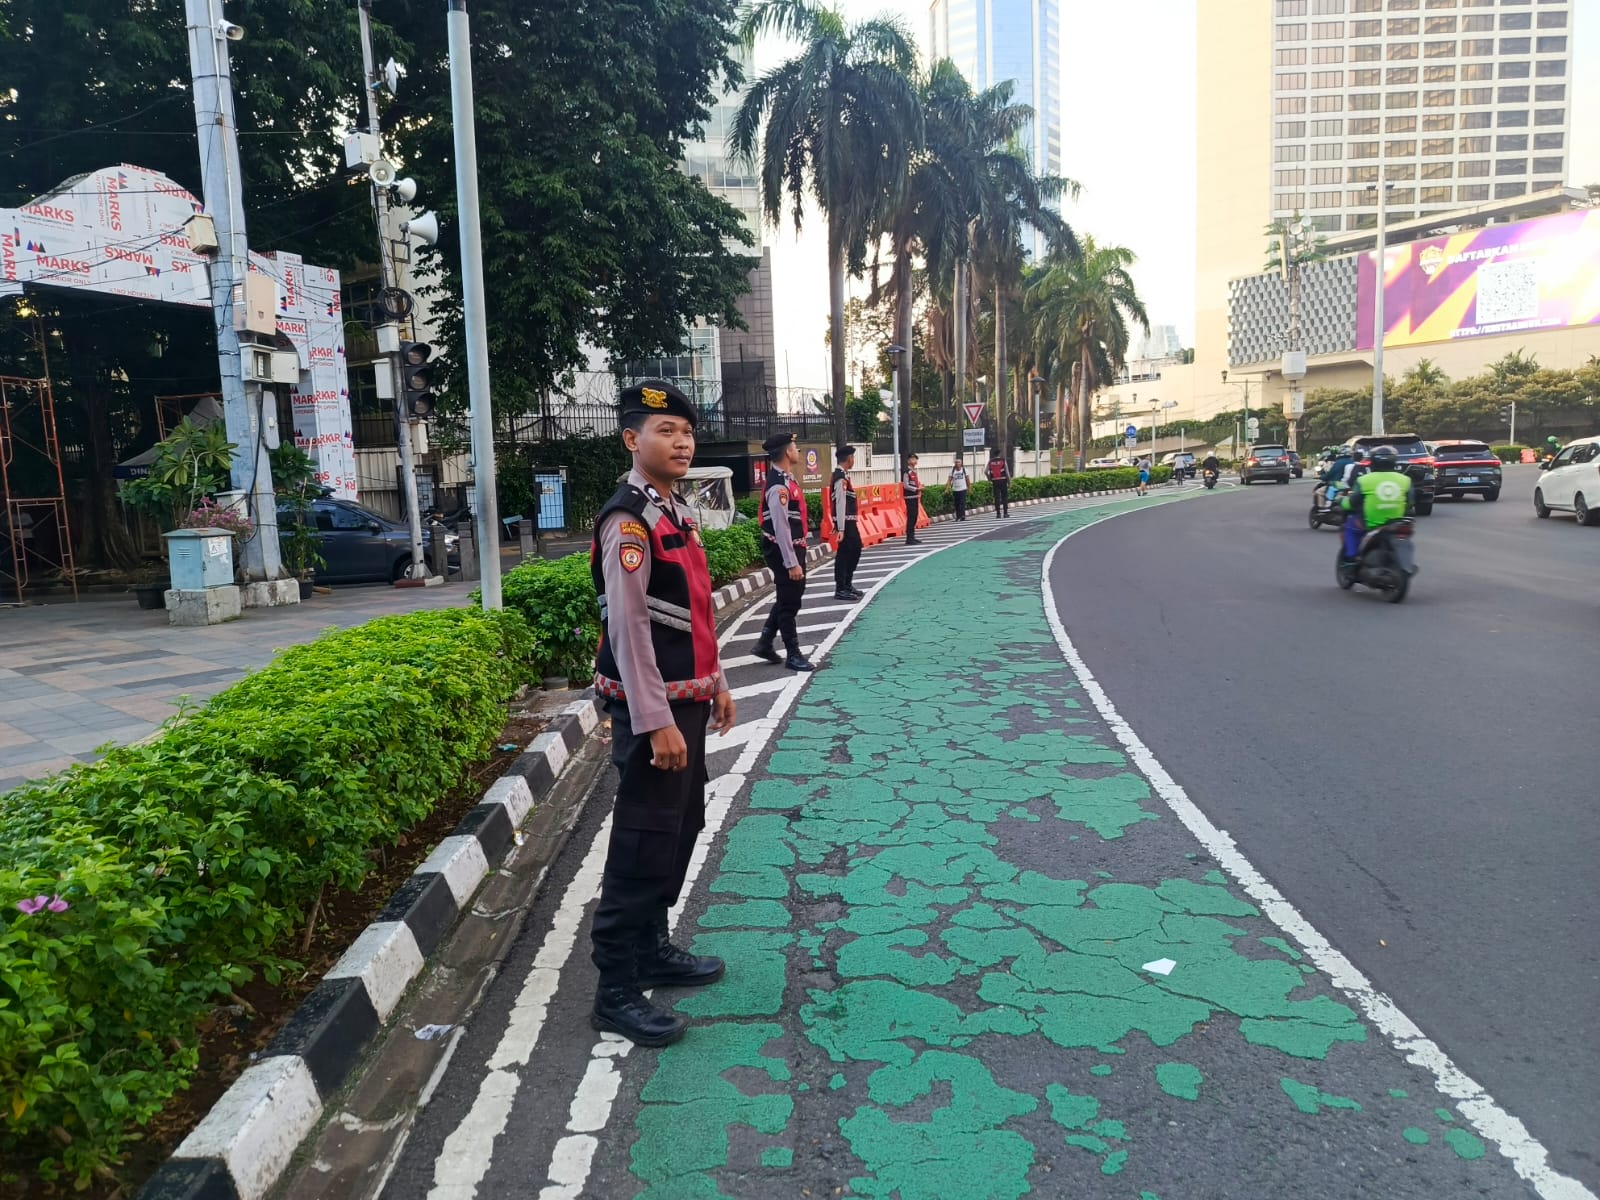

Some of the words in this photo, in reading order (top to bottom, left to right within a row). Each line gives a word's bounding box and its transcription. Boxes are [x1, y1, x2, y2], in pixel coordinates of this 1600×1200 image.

[107, 176, 122, 232] MARKS
[36, 254, 91, 274] MARKS
[104, 246, 153, 265] MARKS
